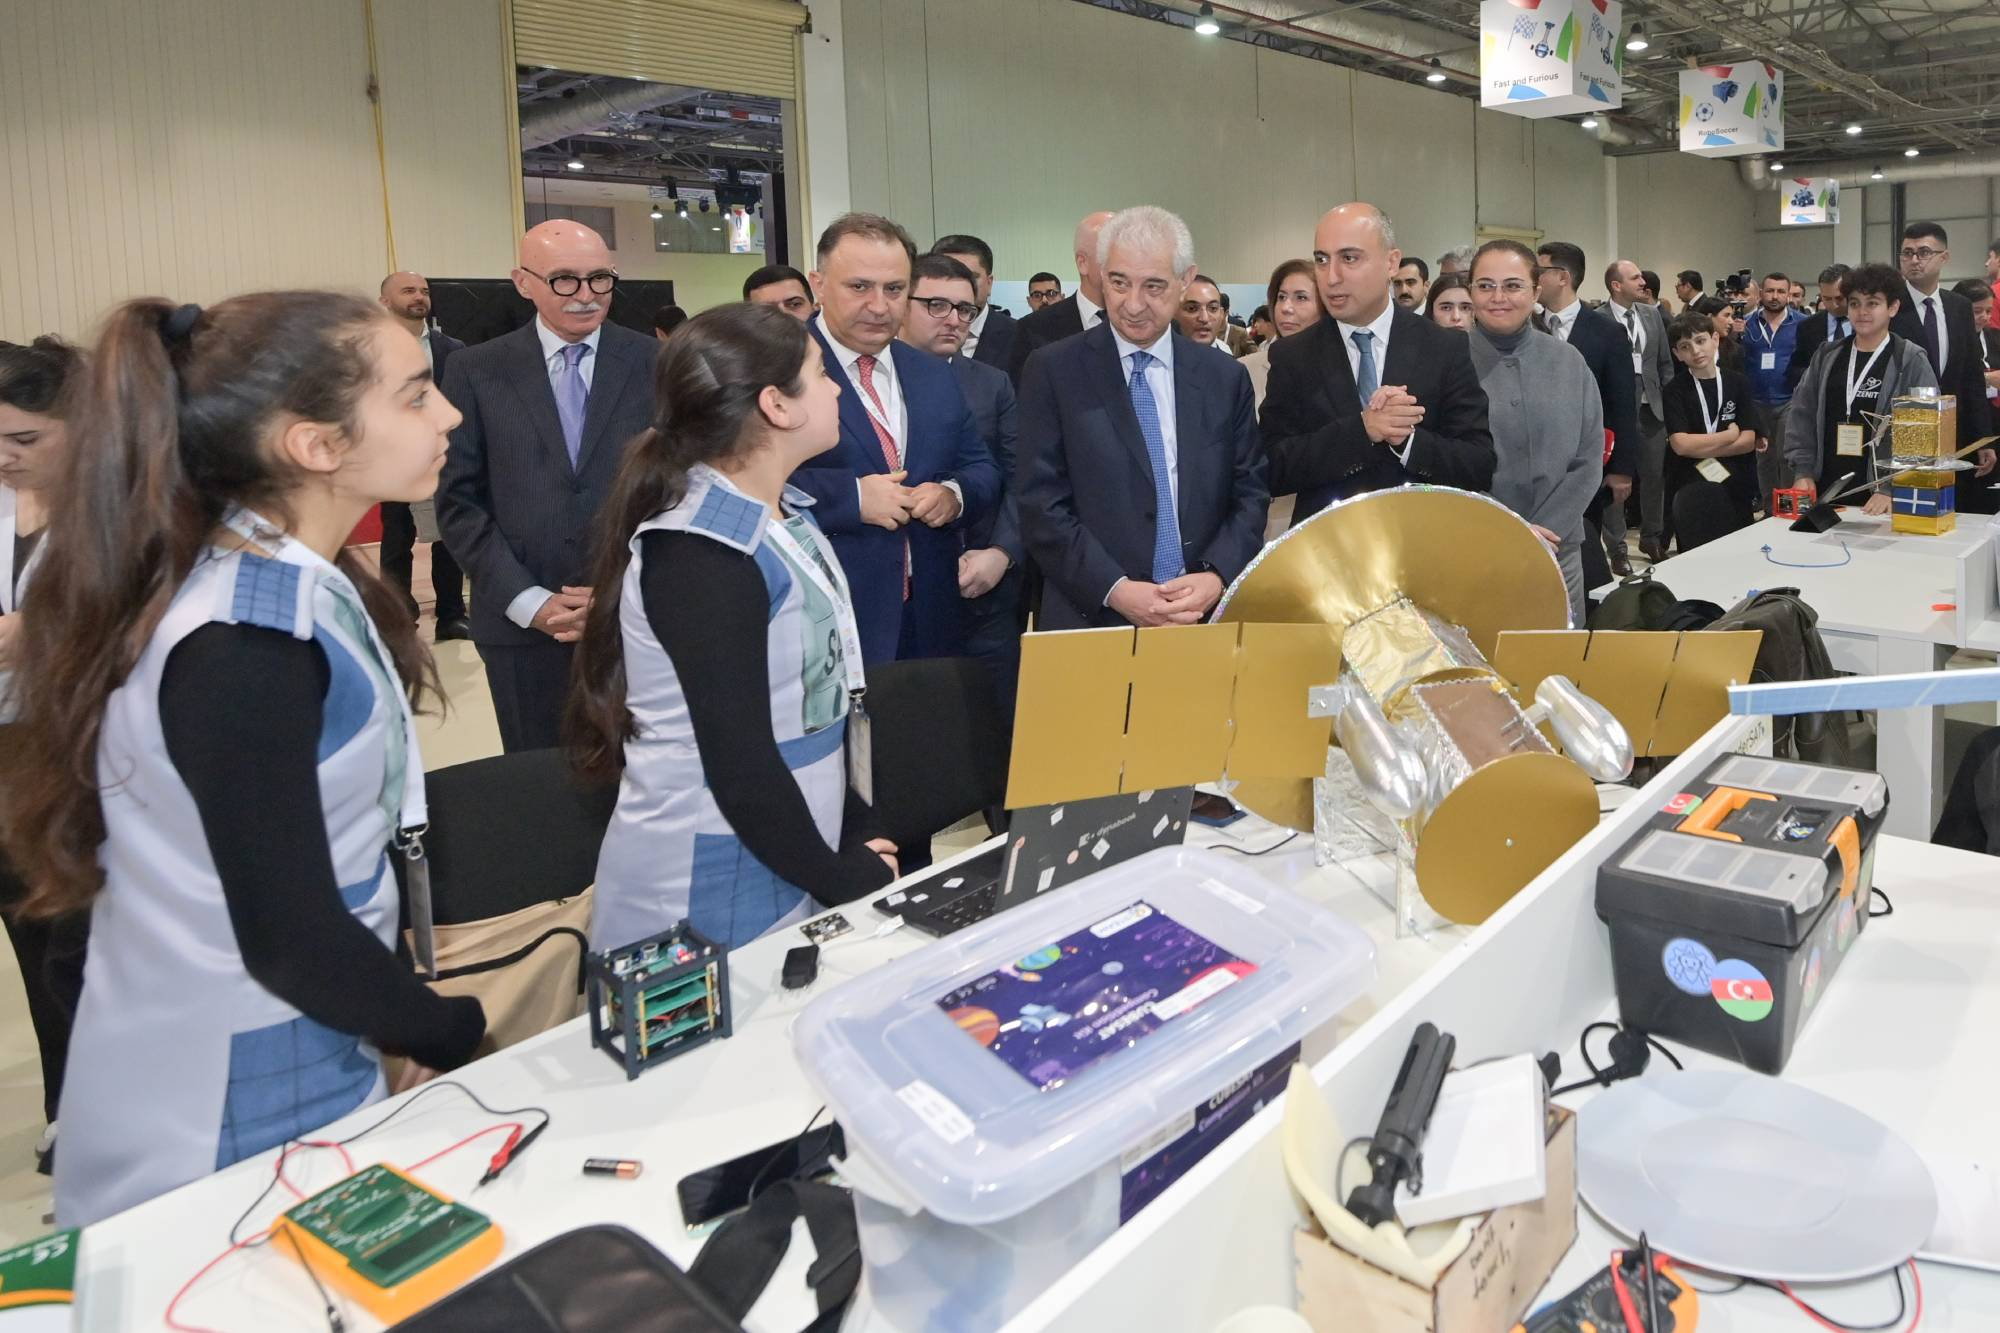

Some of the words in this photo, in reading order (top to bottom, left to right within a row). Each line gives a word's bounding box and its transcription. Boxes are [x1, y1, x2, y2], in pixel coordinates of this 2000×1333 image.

[1493, 79, 1510, 89] Fast
[1512, 78, 1526, 87] and
[1528, 71, 1559, 84] Furious
[1698, 126, 1738, 137] RoboSoccer
[1855, 390, 1880, 399] ZENIT
